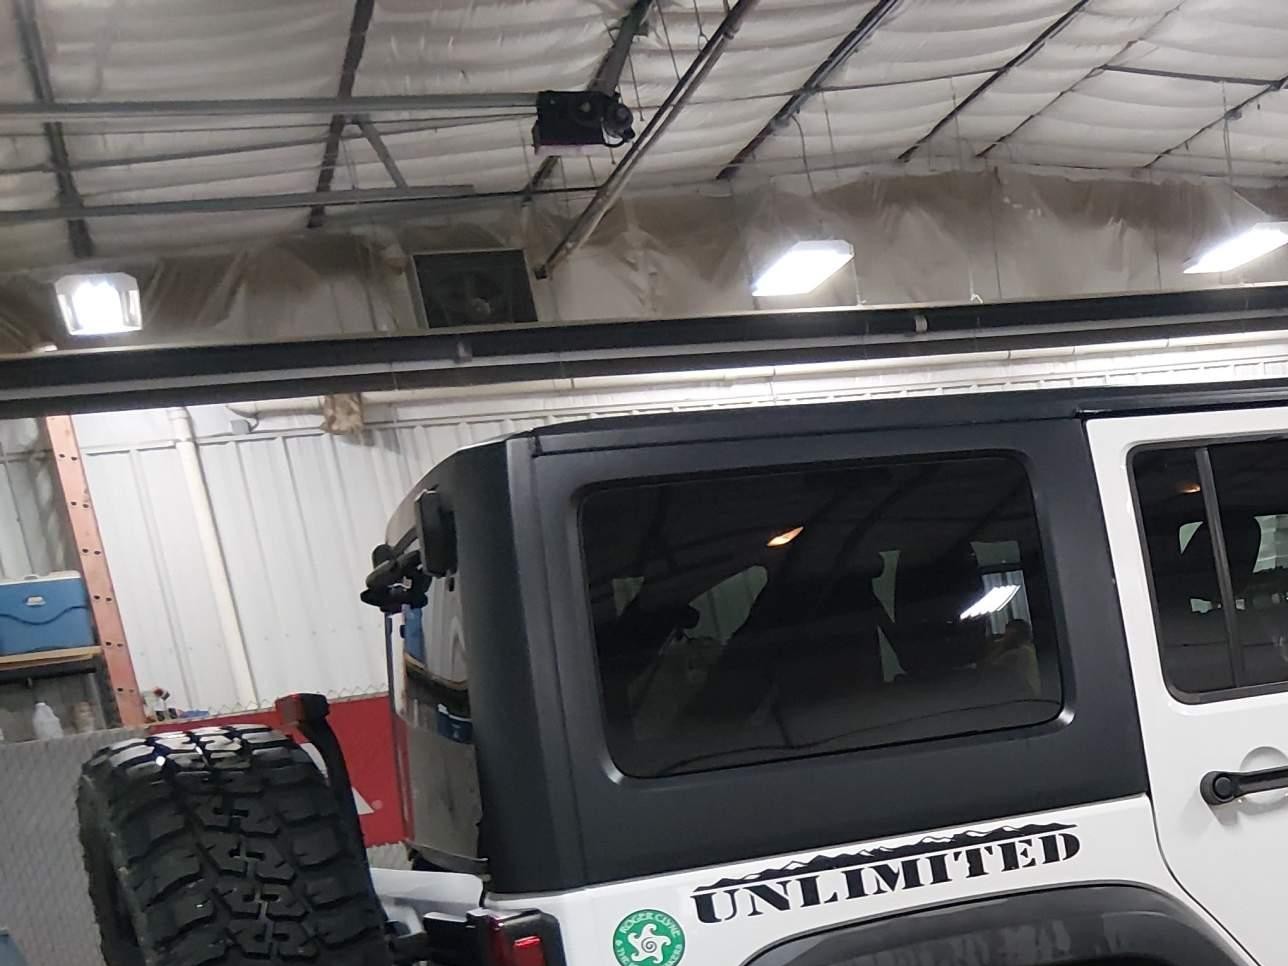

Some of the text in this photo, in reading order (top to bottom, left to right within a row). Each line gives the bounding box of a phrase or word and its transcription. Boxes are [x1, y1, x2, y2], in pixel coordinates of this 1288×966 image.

[690, 833, 1082, 923] UNLIMITED
[619, 912, 681, 938] ROGER CLYNE
